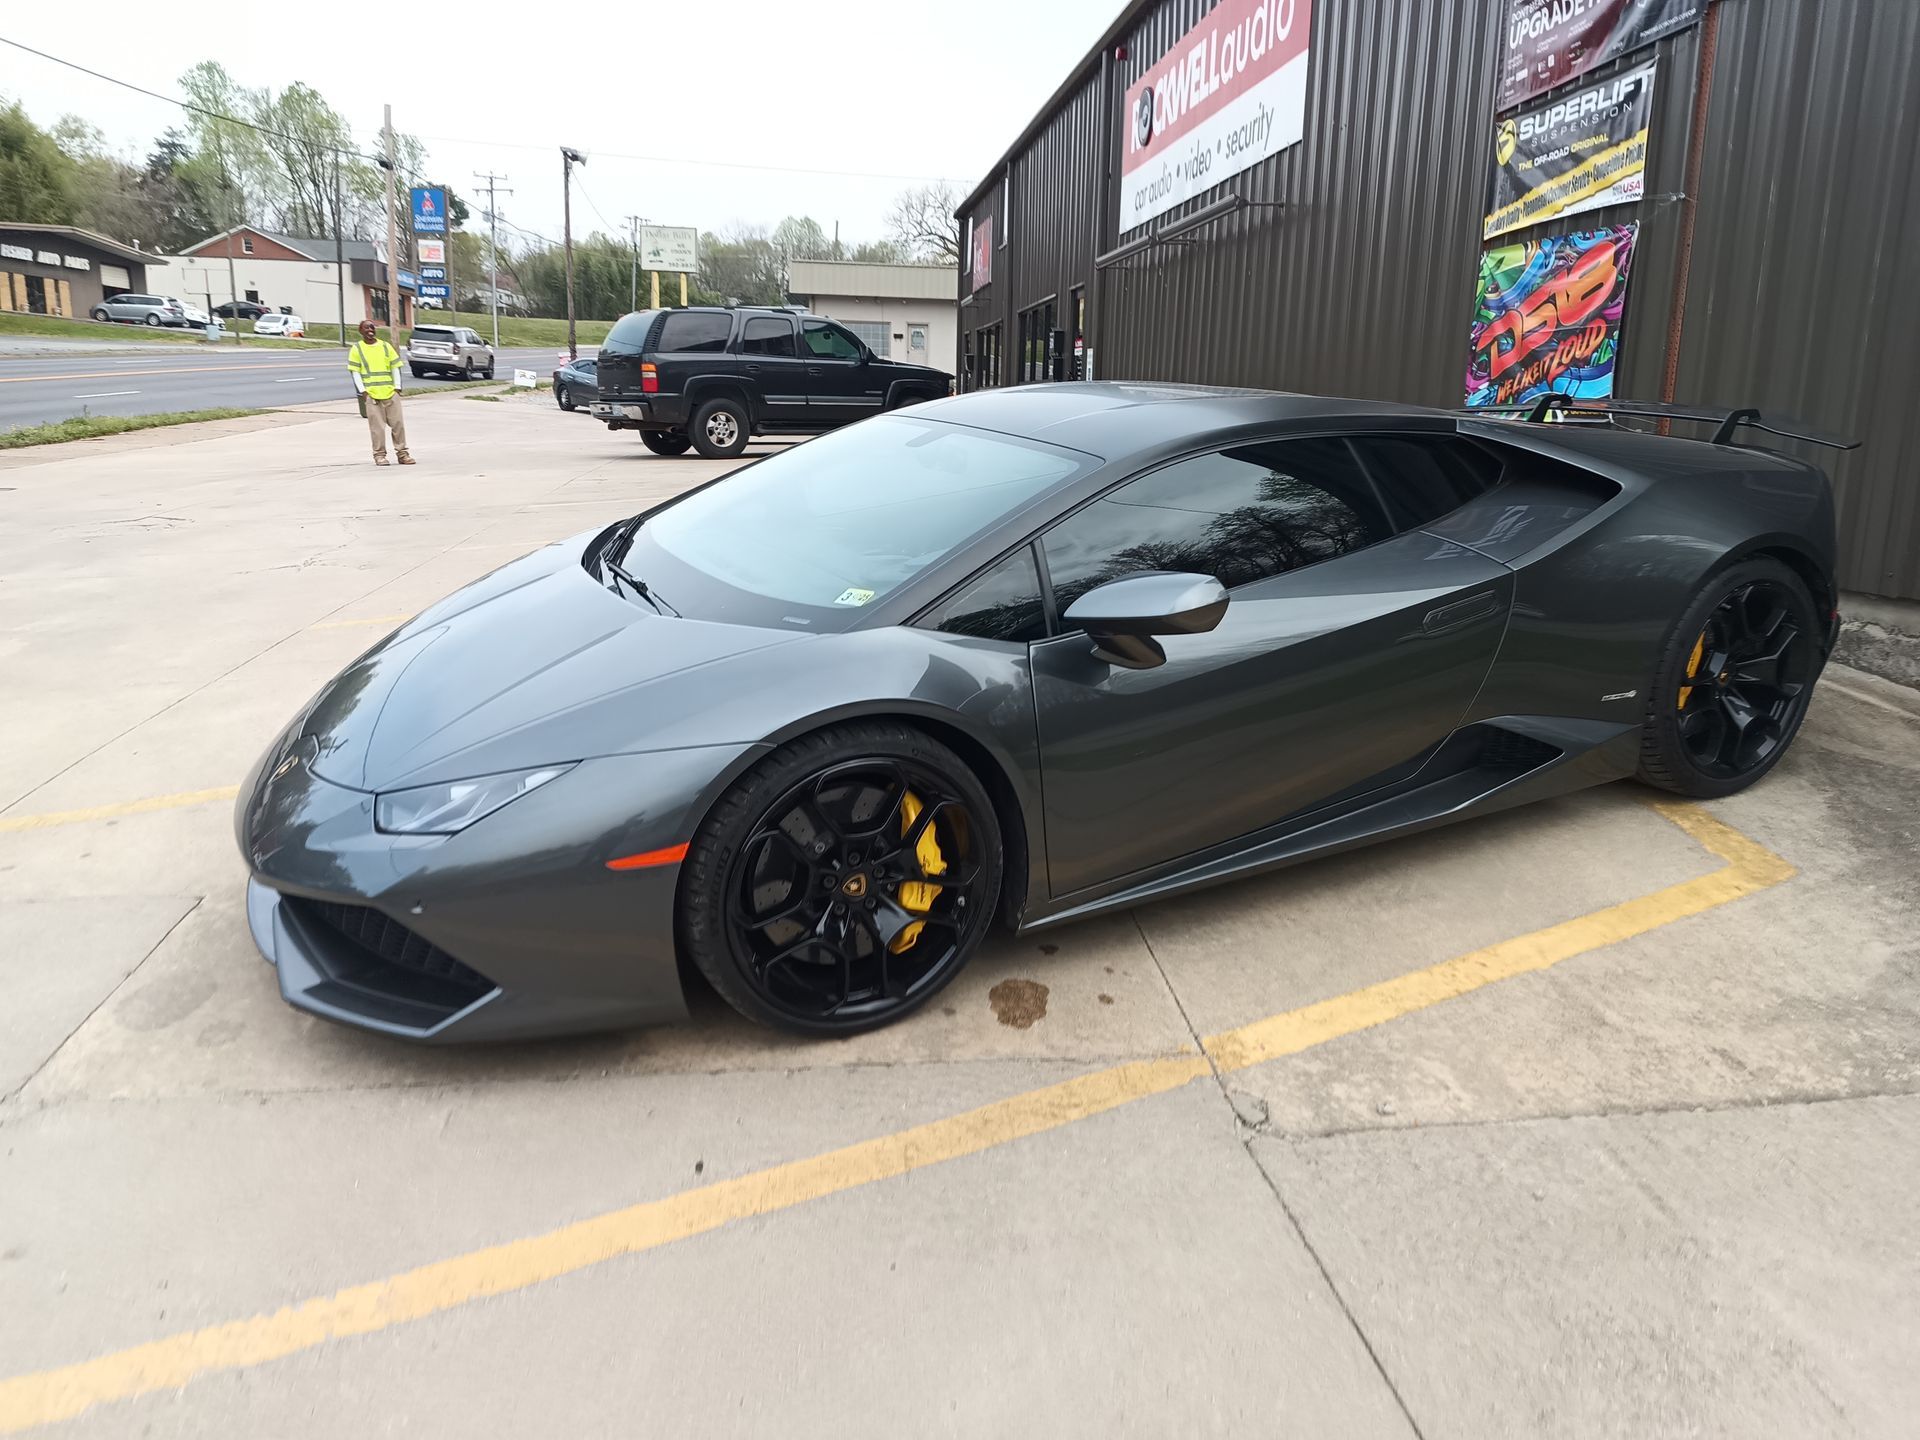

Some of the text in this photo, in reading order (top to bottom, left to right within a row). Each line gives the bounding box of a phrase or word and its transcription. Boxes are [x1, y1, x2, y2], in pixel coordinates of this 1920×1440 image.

[1519, 67, 1656, 141] SUPERLIFT
[1531, 101, 1633, 147] SUSPENSION
[1135, 102, 1274, 211] car audio video security
[1518, 133, 1609, 171] THE OFF-ROAD ORIGINAL
[422, 269, 443, 278] AUTO
[422, 286, 446, 295] PARTS
[1547, 318, 1607, 386] LOUD
